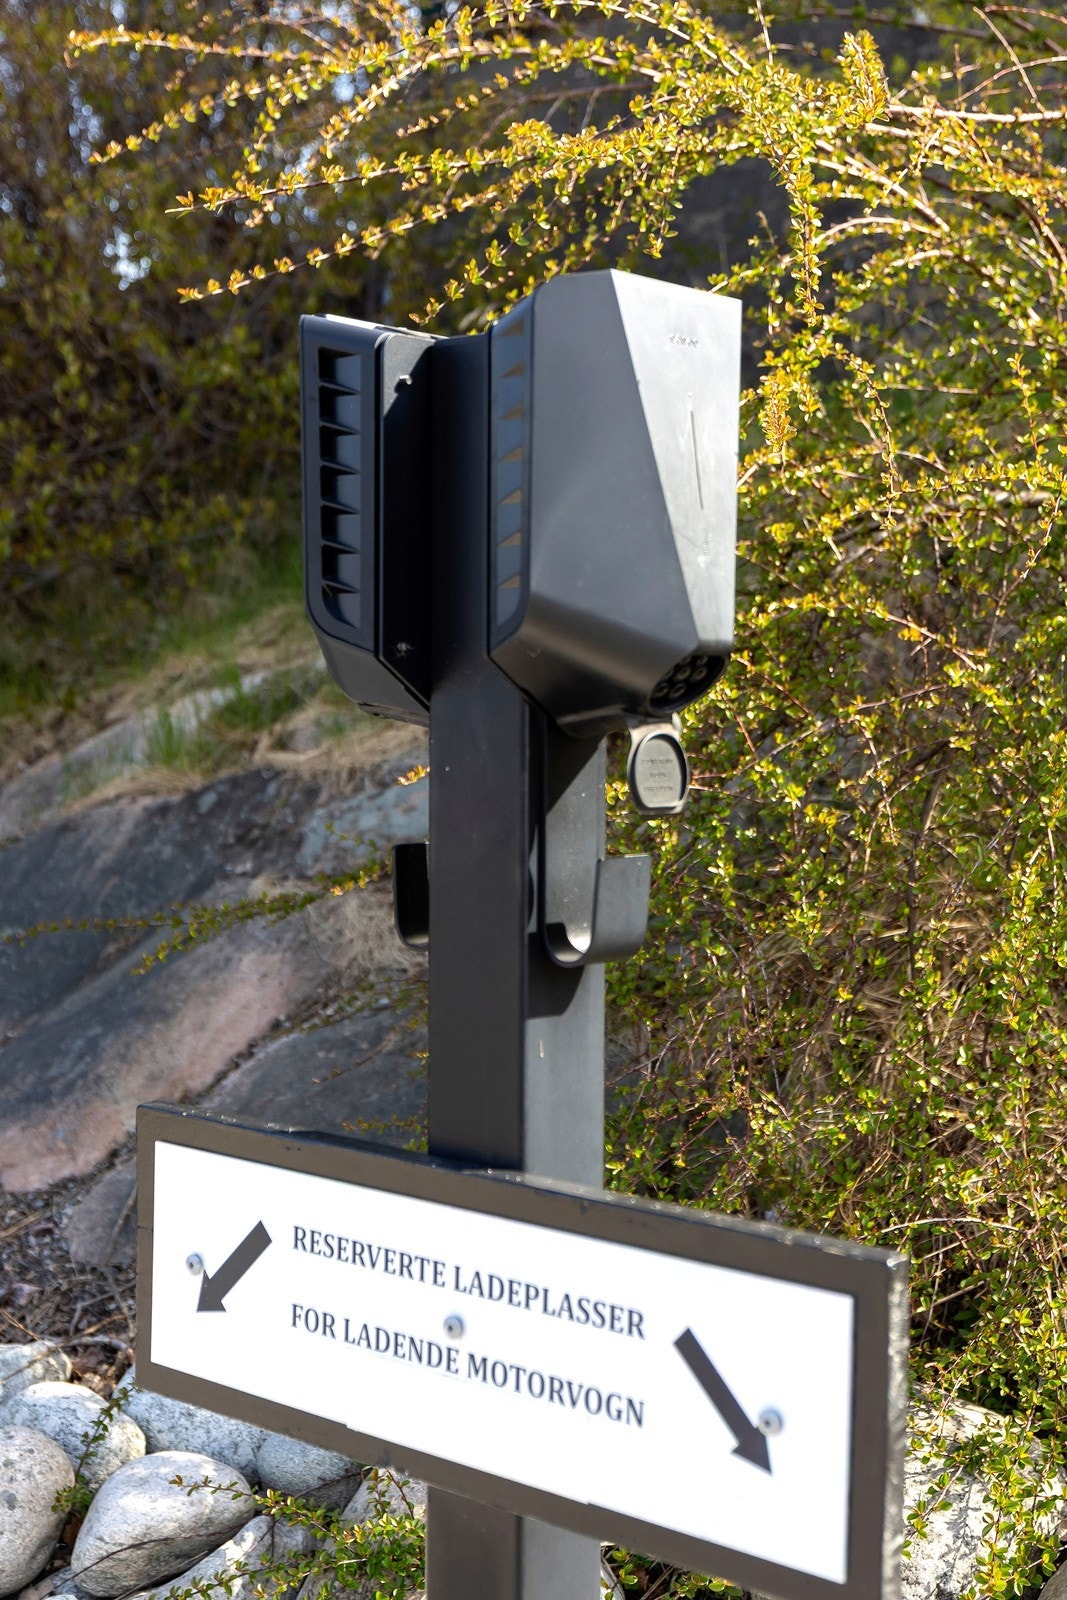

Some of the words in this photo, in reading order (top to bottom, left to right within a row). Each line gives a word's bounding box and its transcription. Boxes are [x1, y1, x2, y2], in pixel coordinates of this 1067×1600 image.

[293, 1225, 446, 1287] RESERVERTE
[453, 1265, 645, 1339] LADEPLASSER
[291, 1303, 336, 1339] FOR
[343, 1318, 459, 1374] LADENDE
[467, 1352, 645, 1428] MOTORVOGN
